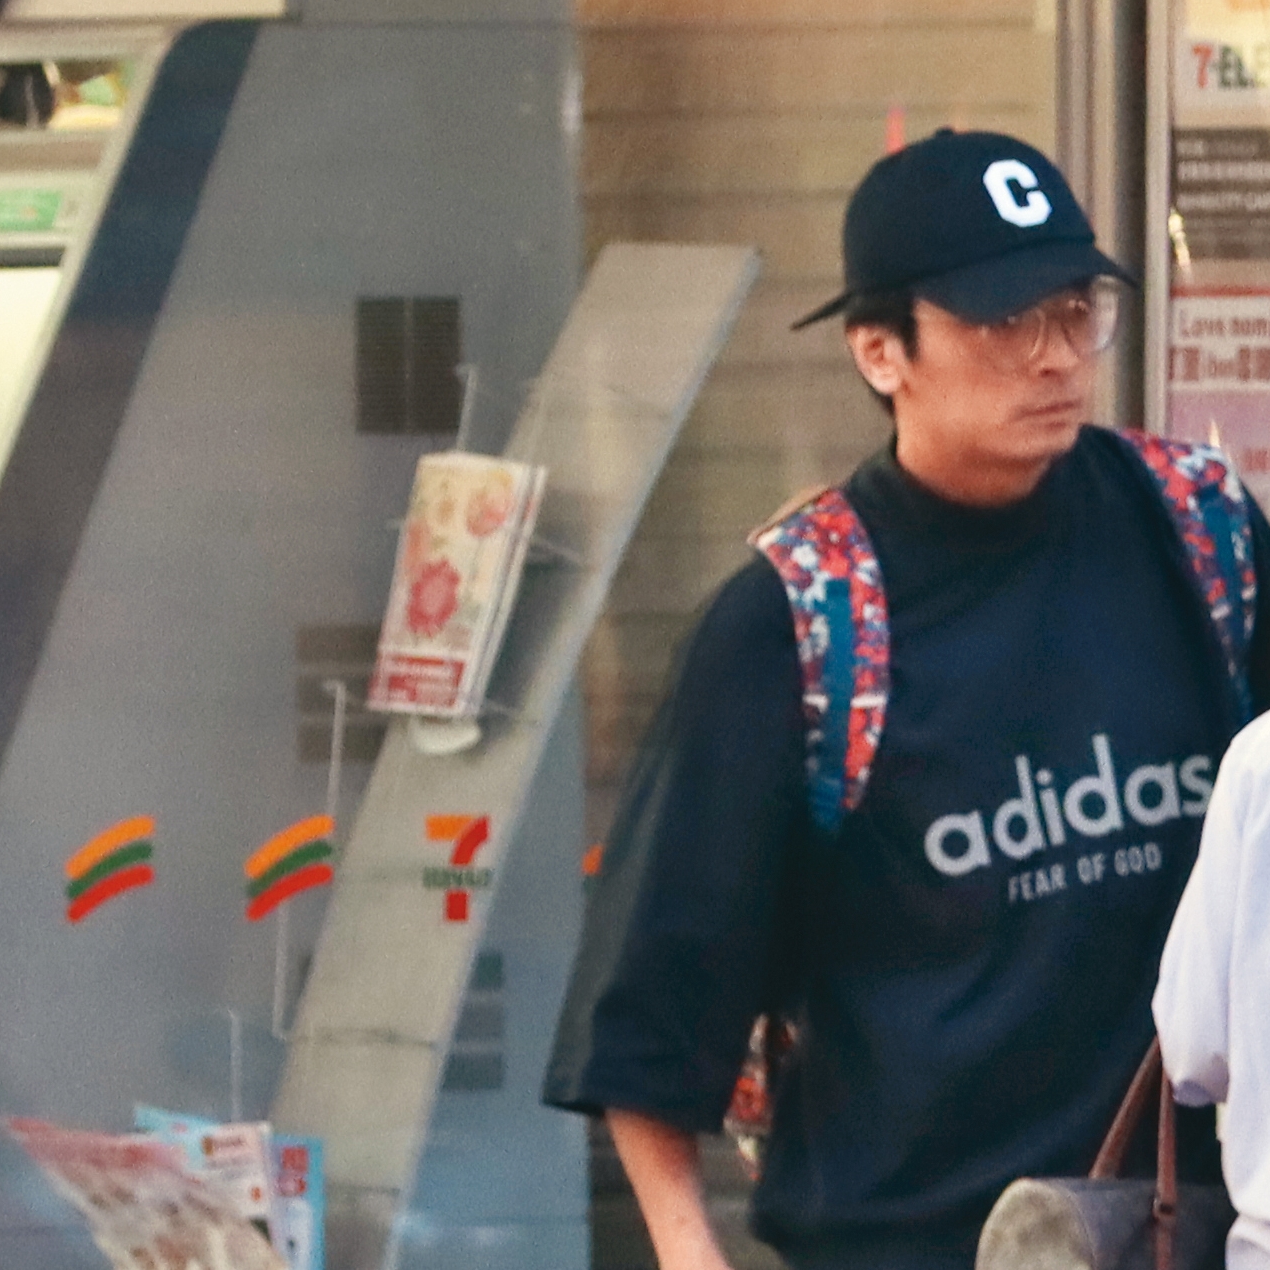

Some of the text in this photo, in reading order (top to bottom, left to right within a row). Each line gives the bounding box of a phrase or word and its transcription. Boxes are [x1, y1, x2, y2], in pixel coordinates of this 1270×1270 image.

[982, 158, 1053, 229] C
[924, 733, 1213, 877] adidas
[1007, 842, 1163, 904] FEAR OF GOD
